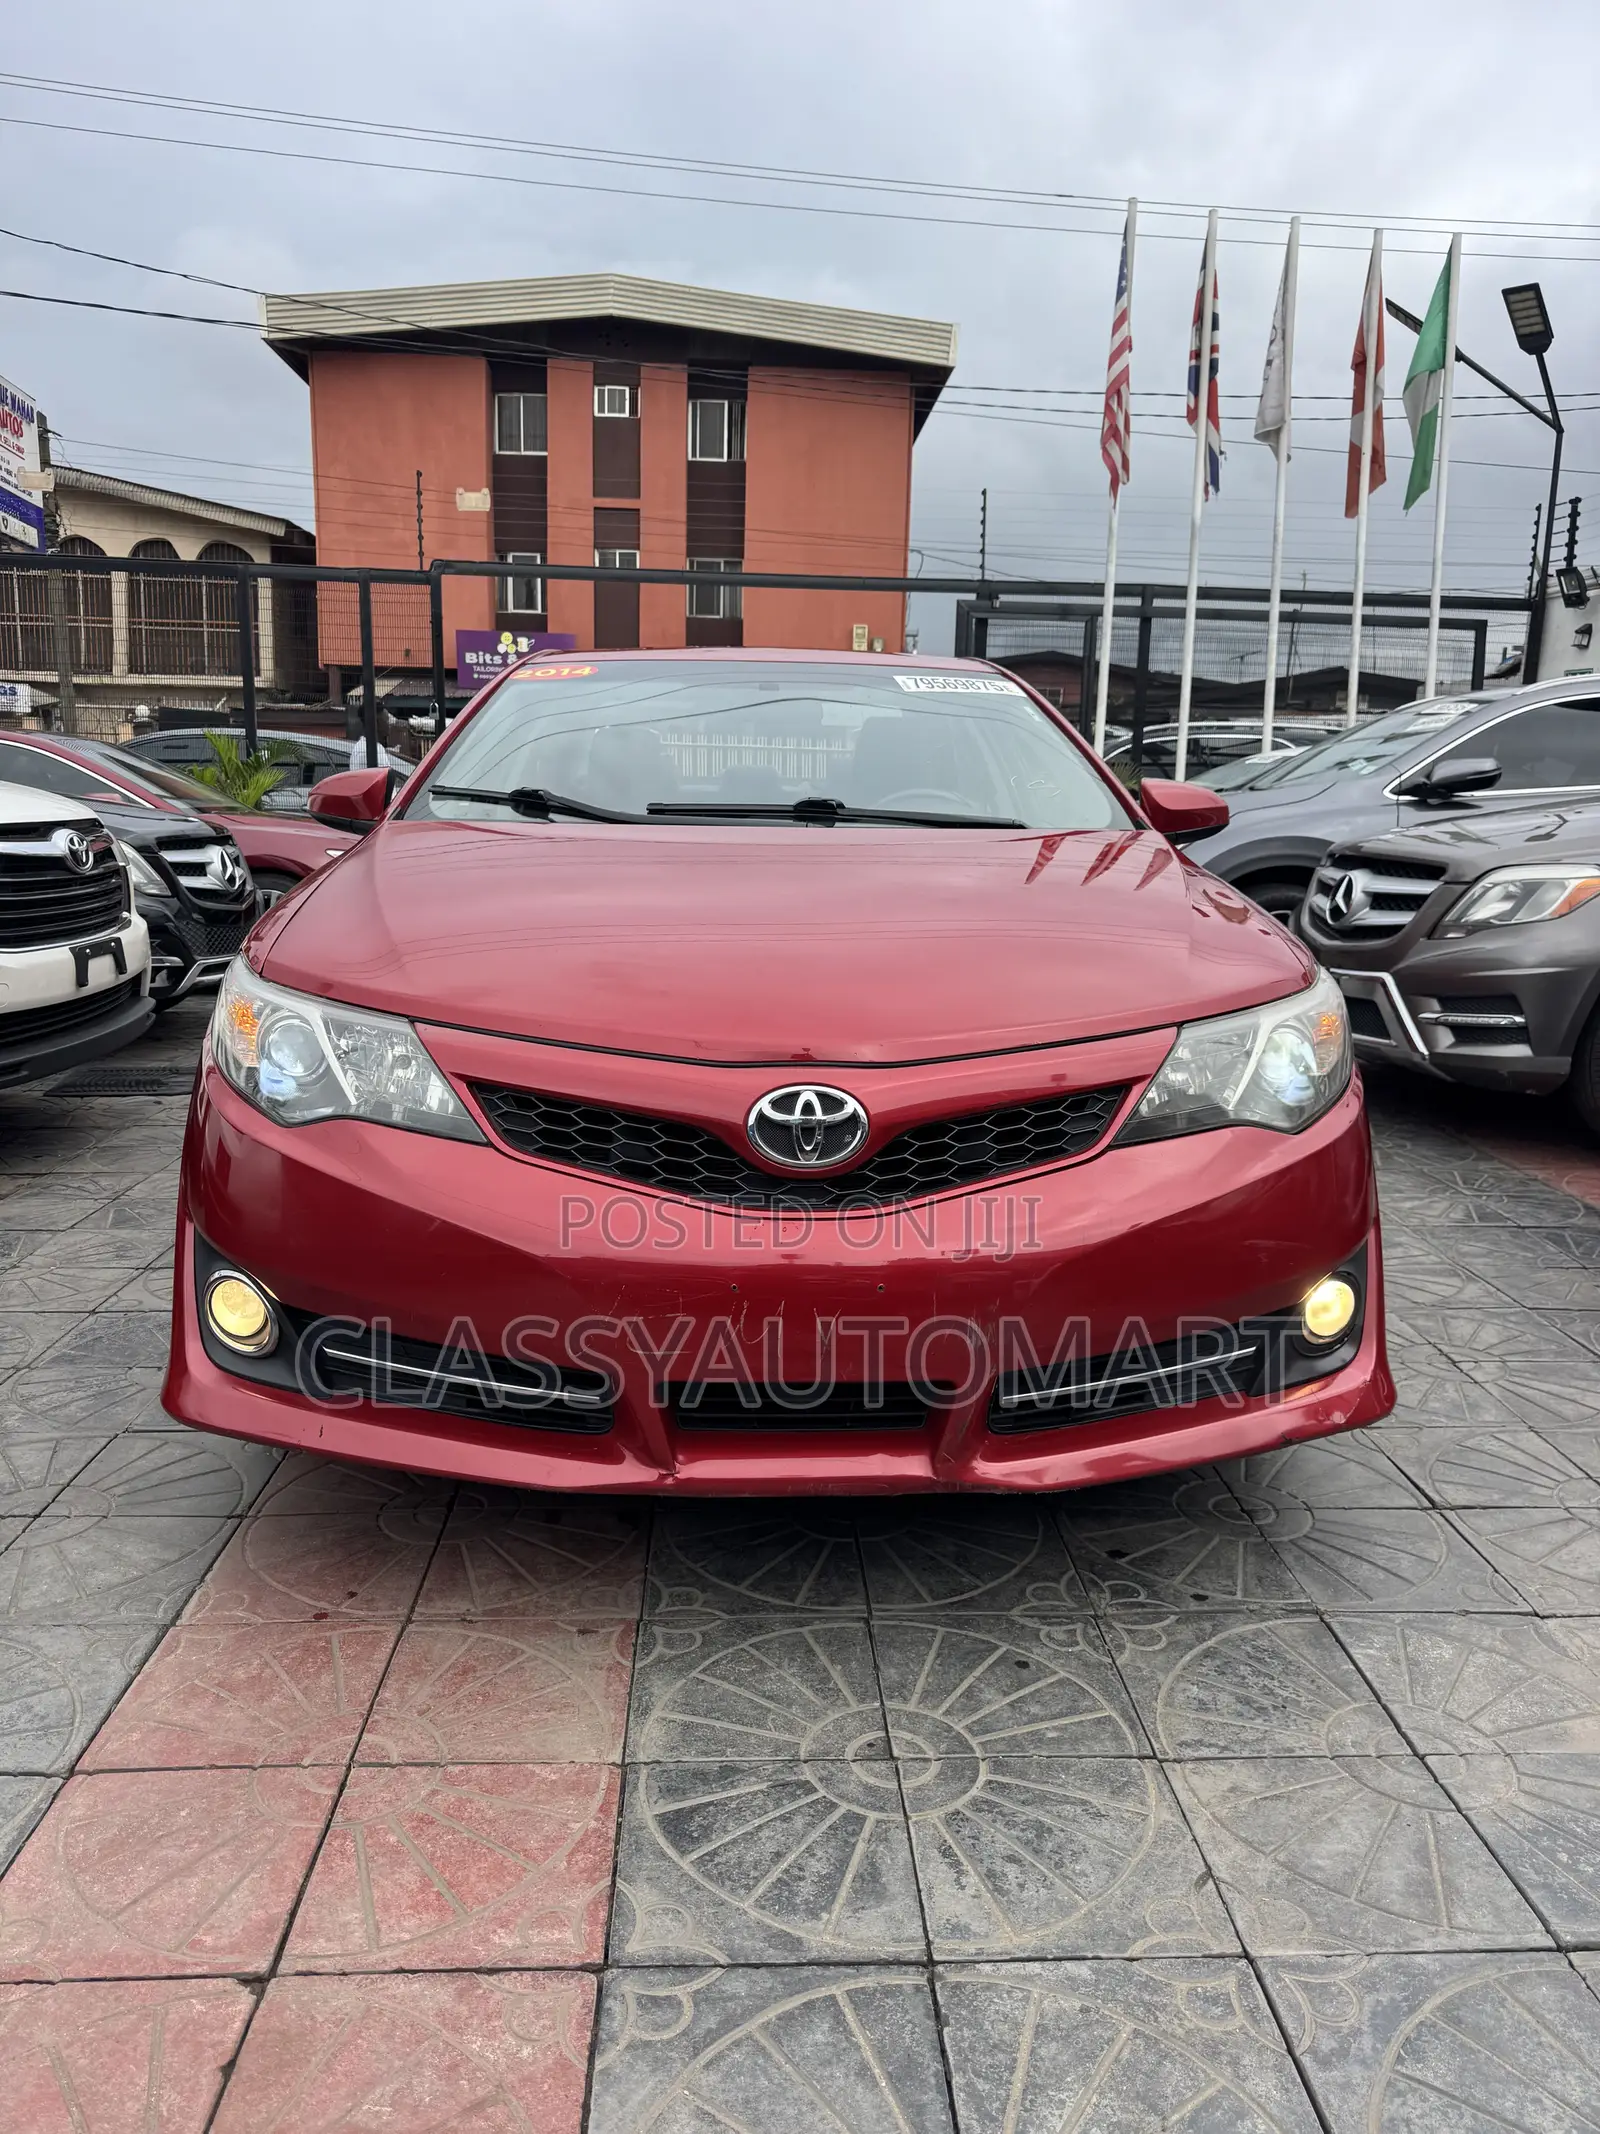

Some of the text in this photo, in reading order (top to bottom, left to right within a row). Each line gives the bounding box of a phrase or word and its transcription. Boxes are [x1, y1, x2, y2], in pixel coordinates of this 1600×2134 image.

[465, 651, 517, 665] Bits &
[513, 666, 593, 679] 2014
[906, 677, 1003, 692] 79569875
